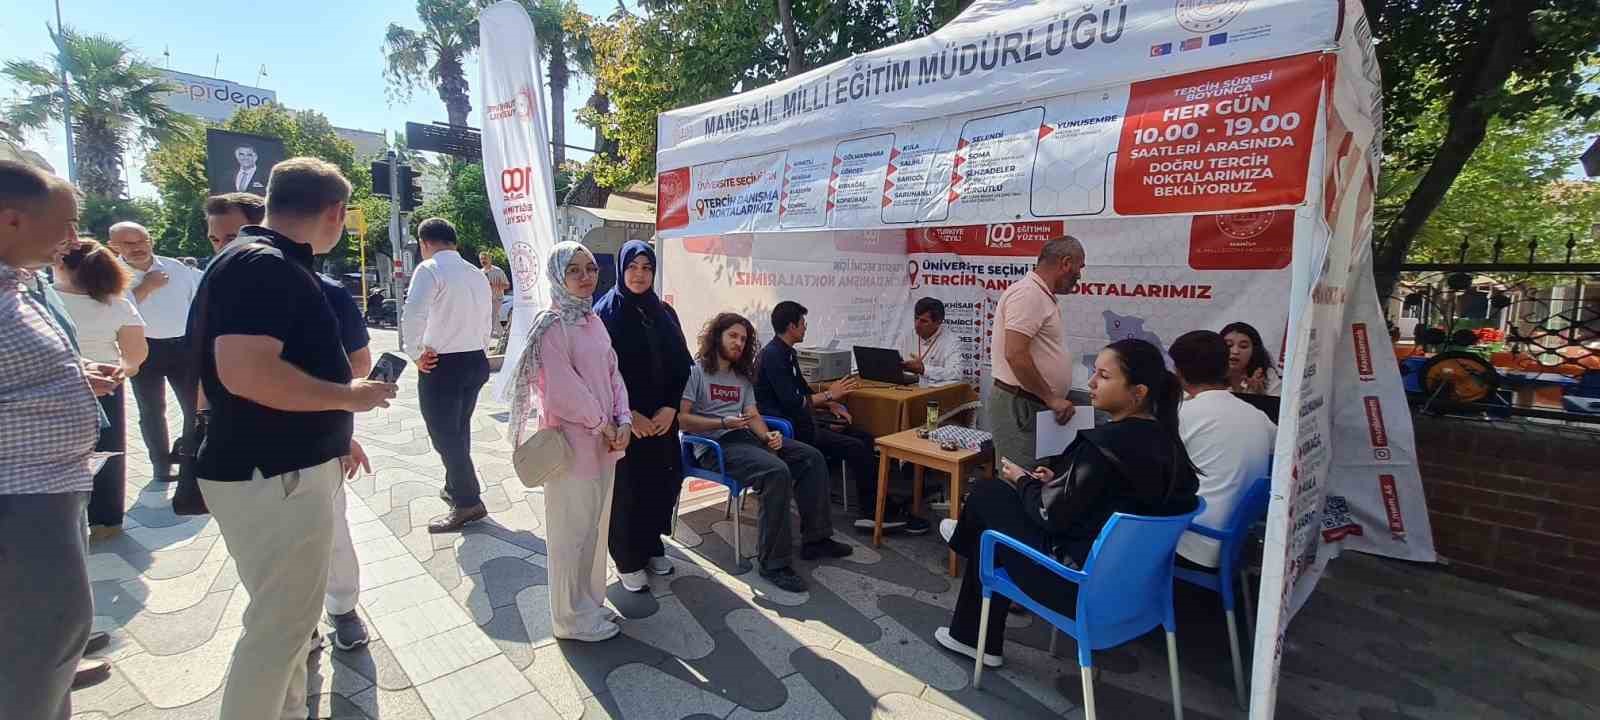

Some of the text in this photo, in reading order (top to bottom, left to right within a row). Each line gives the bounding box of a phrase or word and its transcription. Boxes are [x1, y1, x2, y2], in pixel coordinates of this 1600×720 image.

[704, 0, 1128, 136] MANİSA İL MİLLİ EĞİTİM MÜDÜRLÜĞÜ
[1175, 70, 1273, 97] TERCİH SÜRESİ
[1186, 84, 1253, 101] BOYUNCA
[1163, 94, 1271, 122] HER GÜN
[1057, 113, 1119, 129] YUNUSEMRE
[1133, 122, 1200, 145] 10.00
[1224, 112, 1301, 137] 19.00
[967, 151, 990, 160] SOMA
[1129, 136, 1295, 160] SAATLERİ ARASINDA
[1149, 153, 1269, 173] DOĞRU TERCİH
[1143, 168, 1274, 186] NOKTALARIMIZA
[1154, 181, 1257, 198] BEKLİYORUZ.
[922, 272, 977, 287] TERCİH
[1071, 282, 1212, 299] OKTALARIMIZ
